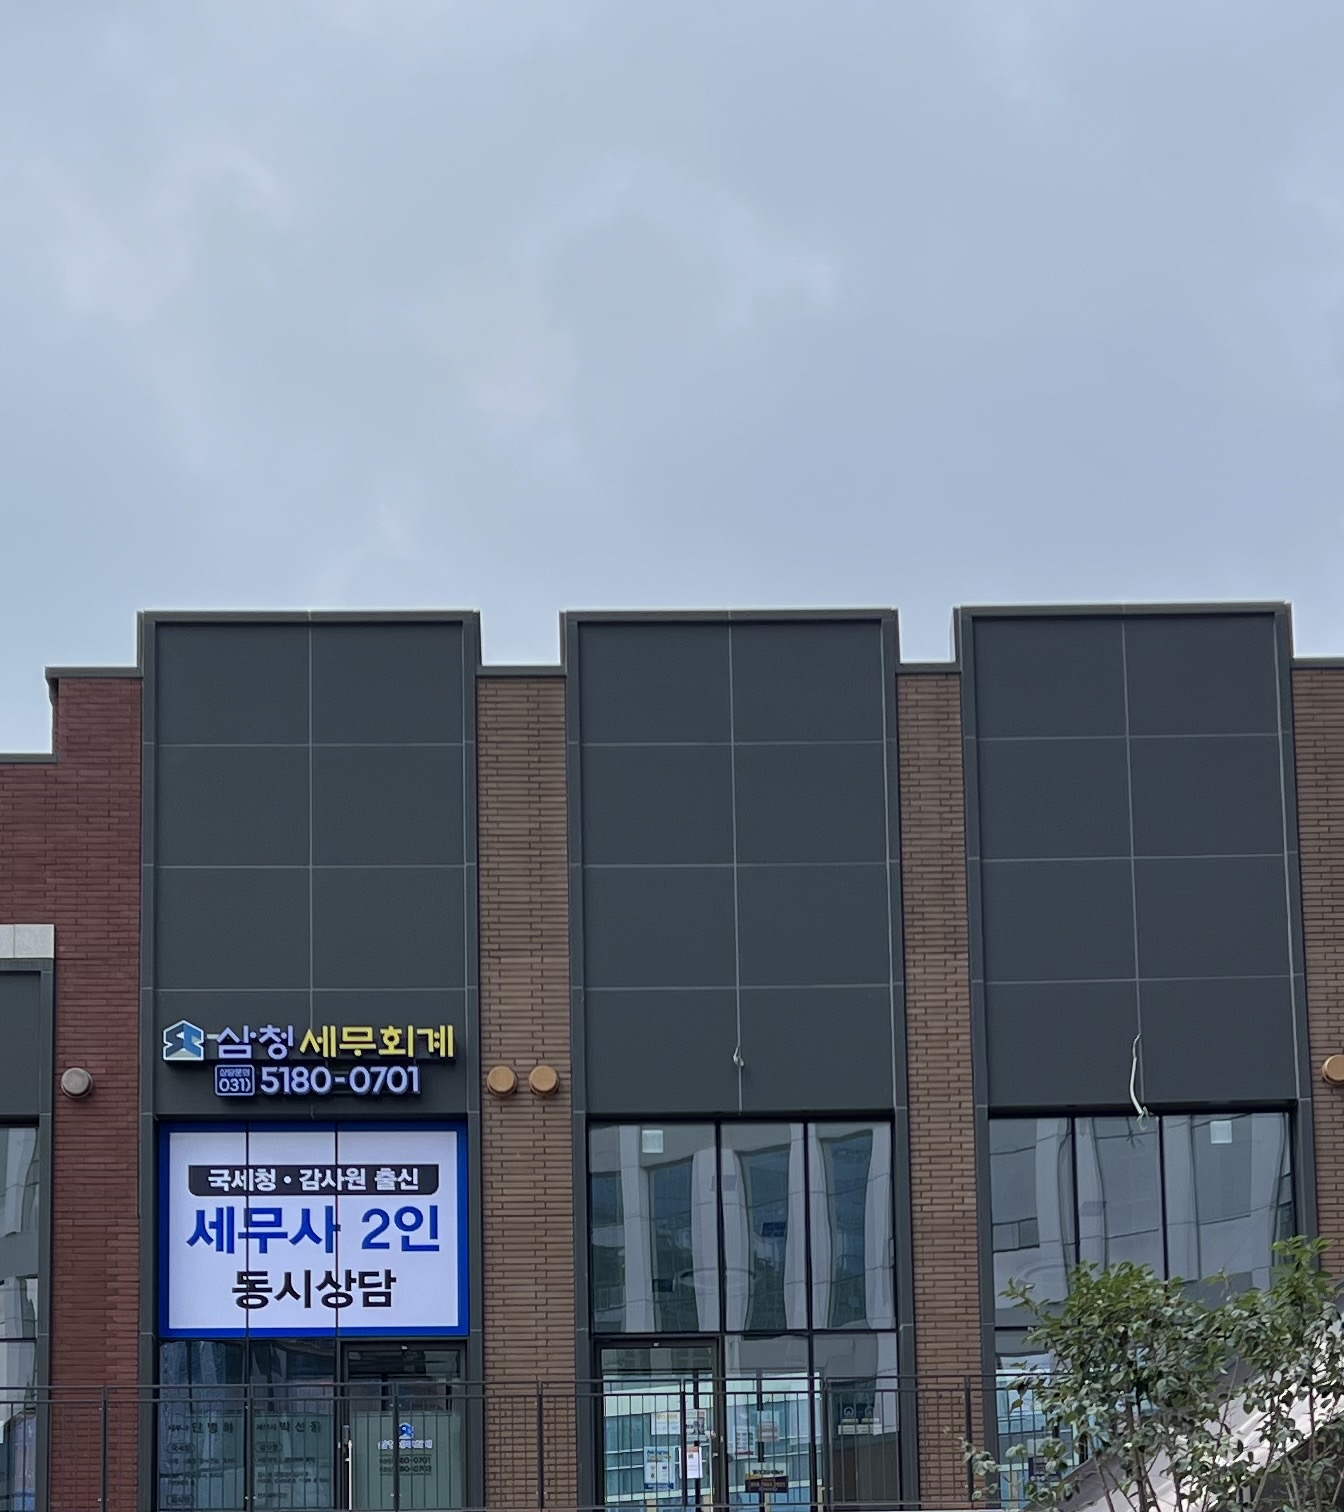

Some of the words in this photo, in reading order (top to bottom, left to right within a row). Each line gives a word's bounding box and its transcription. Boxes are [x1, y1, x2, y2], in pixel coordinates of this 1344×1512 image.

[216, 1025, 294, 1060] 삼청
[299, 1024, 454, 1059] 세무회계
[219, 1078, 251, 1092] 031)
[260, 1066, 421, 1095] 5180-0701
[207, 1168, 277, 1191] 국세청
[299, 1168, 367, 1191] 감사원
[374, 1167, 419, 1191] 출신
[186, 1205, 341, 1254] 세무사
[361, 1205, 440, 1252] 2인
[231, 1269, 397, 1310] 동시상담
